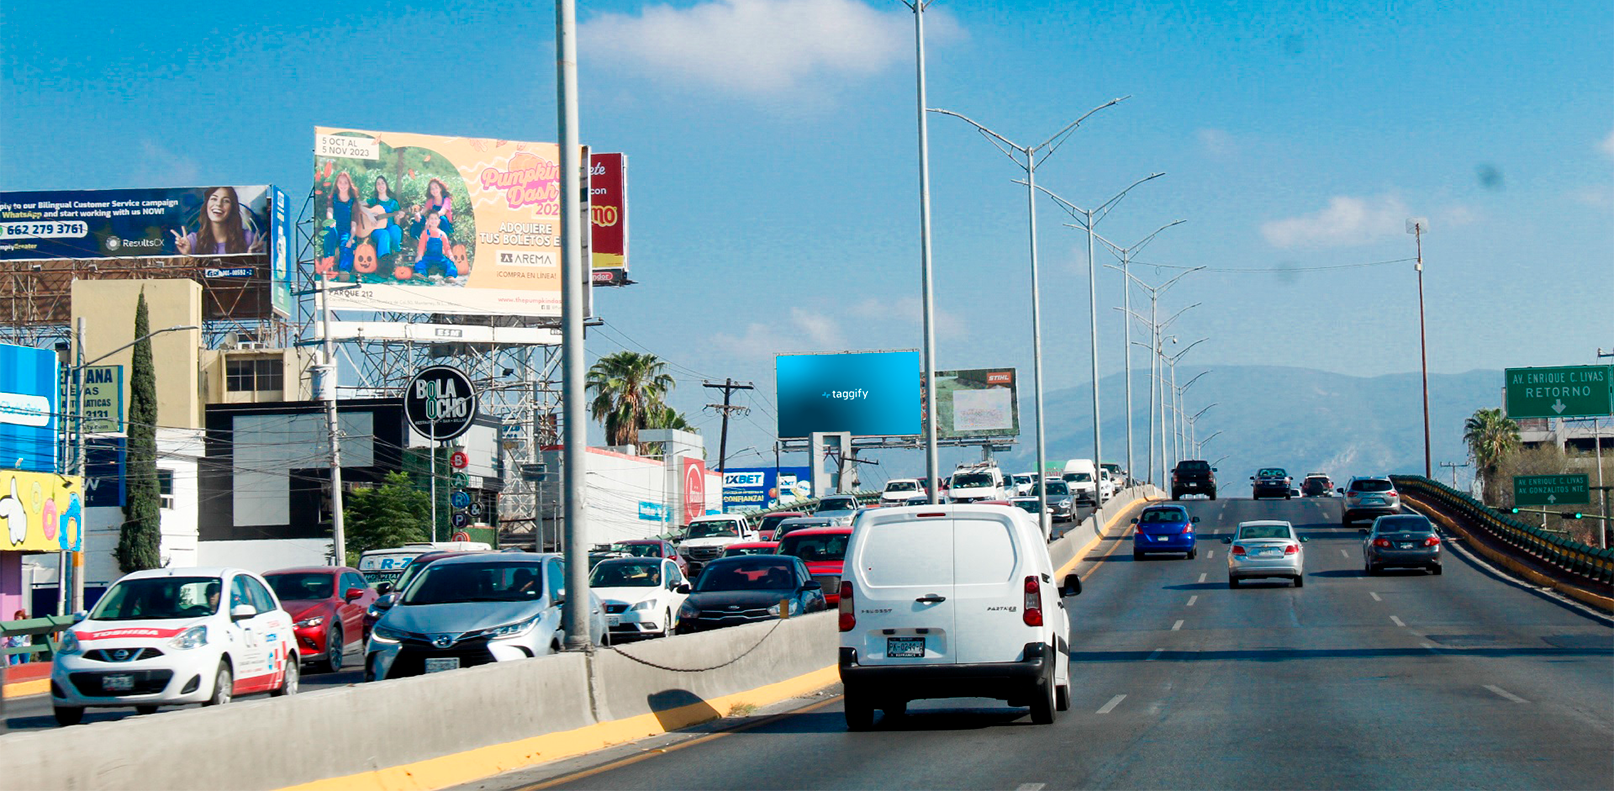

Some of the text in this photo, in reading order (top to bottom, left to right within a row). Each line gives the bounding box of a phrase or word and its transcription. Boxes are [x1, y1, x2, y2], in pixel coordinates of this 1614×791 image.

[329, 138, 345, 146] OCT
[348, 139, 358, 147] AL
[329, 146, 347, 155] NOV
[350, 148, 370, 157] 2023
[506, 183, 559, 208] Dash
[13, 202, 22, 210] to
[23, 202, 37, 210] our
[38, 201, 72, 210] Bilingual
[73, 201, 110, 209] Customer
[111, 199, 140, 208] Service
[142, 198, 179, 208] campaign
[536, 203, 560, 215] 202
[2, 211, 42, 219] WhatsApp
[43, 210, 58, 218] and
[80, 209, 111, 218] working
[112, 208, 130, 216] with
[7, 224, 83, 235] 662 279 3761
[499, 222, 552, 235] ADQUIERE
[122, 238, 165, 248] ResultsCX
[479, 233, 561, 248] TUS BOLETOS E
[514, 254, 552, 264] AREMA
[1513, 371, 1604, 384] AV. ENRIQUE C. LIVAS
[416, 378, 457, 399] BOLA
[832, 388, 869, 400] taggify
[1526, 385, 1591, 398] RETORNO
[426, 397, 467, 419] OCHO
[725, 474, 762, 485] 1XBET
[1528, 477, 1557, 486] ENRIQUE
[1567, 476, 1584, 485] LIVAS
[1529, 486, 1569, 494] GONZALITOS
[92, 629, 159, 638] TOSHIBA
